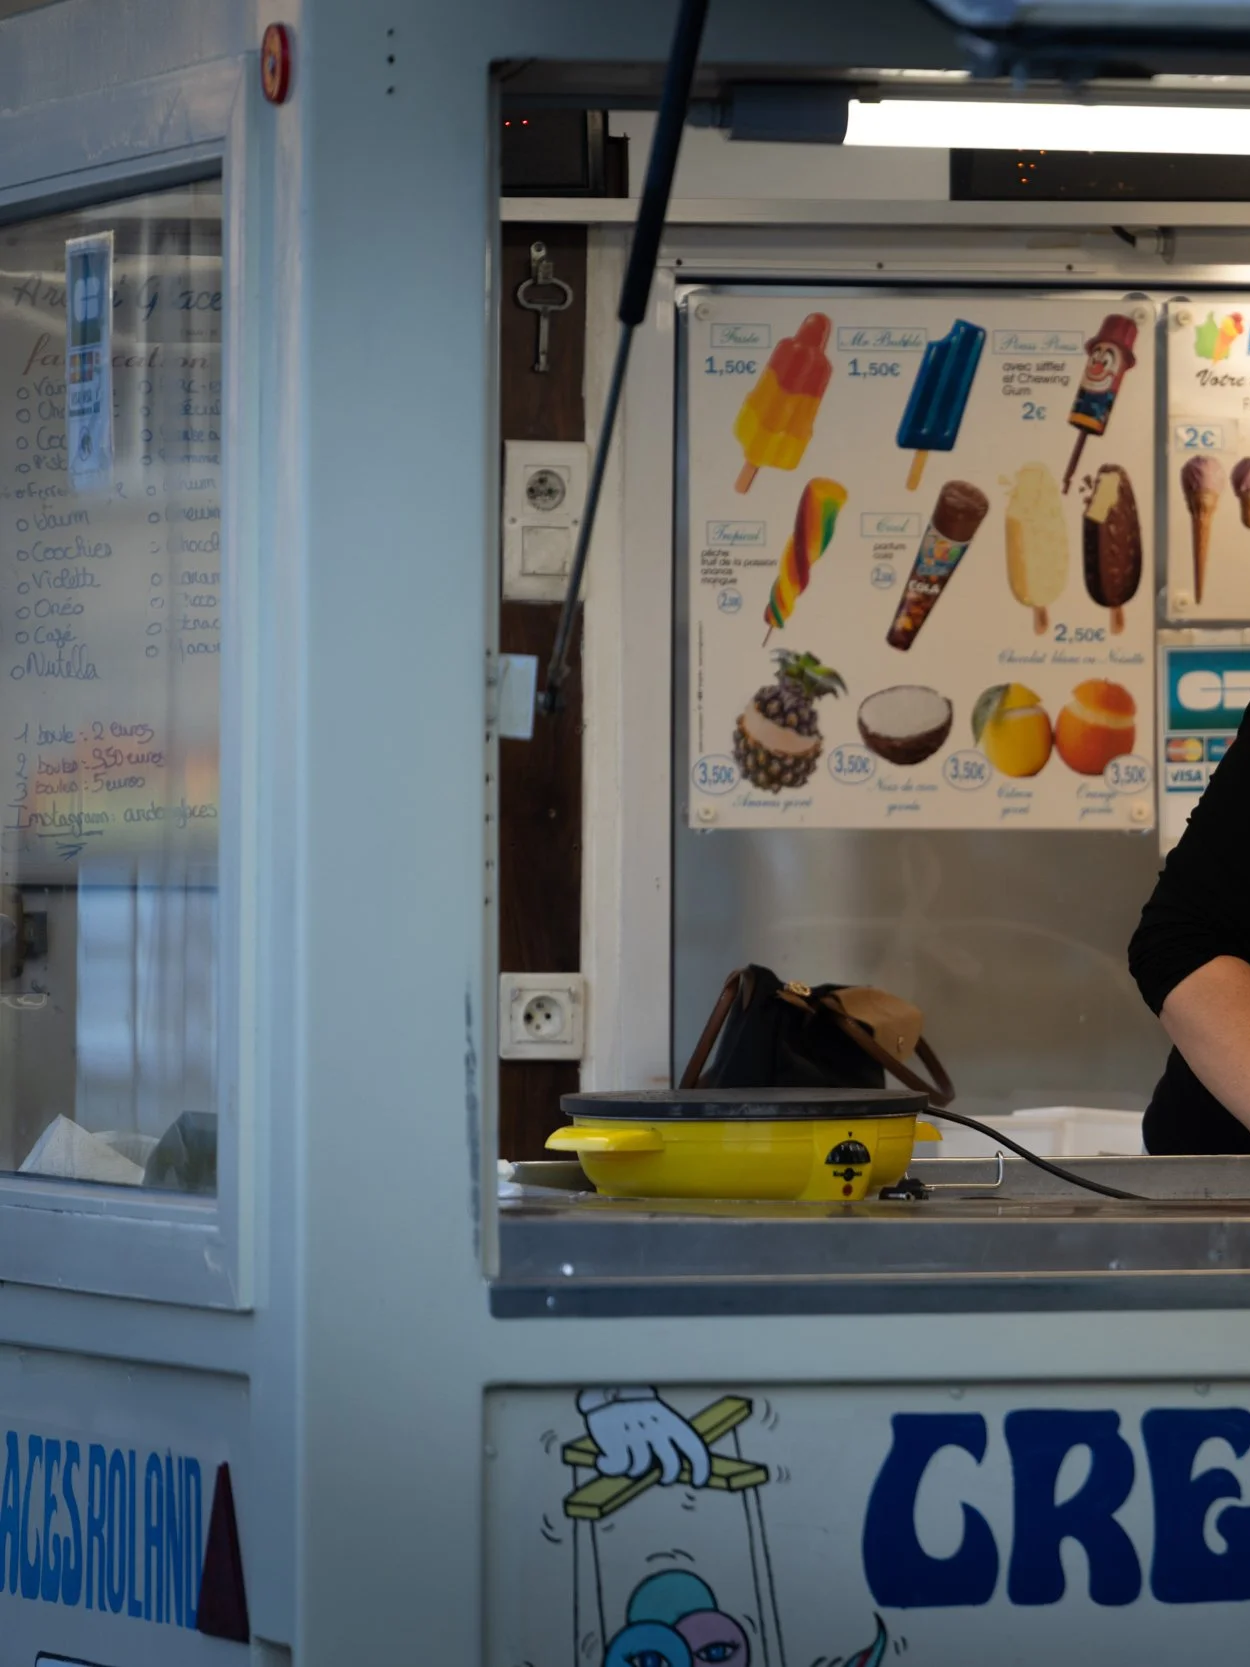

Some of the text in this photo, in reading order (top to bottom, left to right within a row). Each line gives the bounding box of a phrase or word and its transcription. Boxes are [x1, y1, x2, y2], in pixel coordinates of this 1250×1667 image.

[704, 356, 758, 377] 1,50€
[848, 358, 901, 379] 1,50€
[1195, 367, 1246, 388] Votre
[1184, 427, 1216, 448] 2€
[1055, 623, 1106, 644] 2,50€
[1171, 770, 1202, 782] VISA
[86, 1443, 204, 1631] ROLAND
